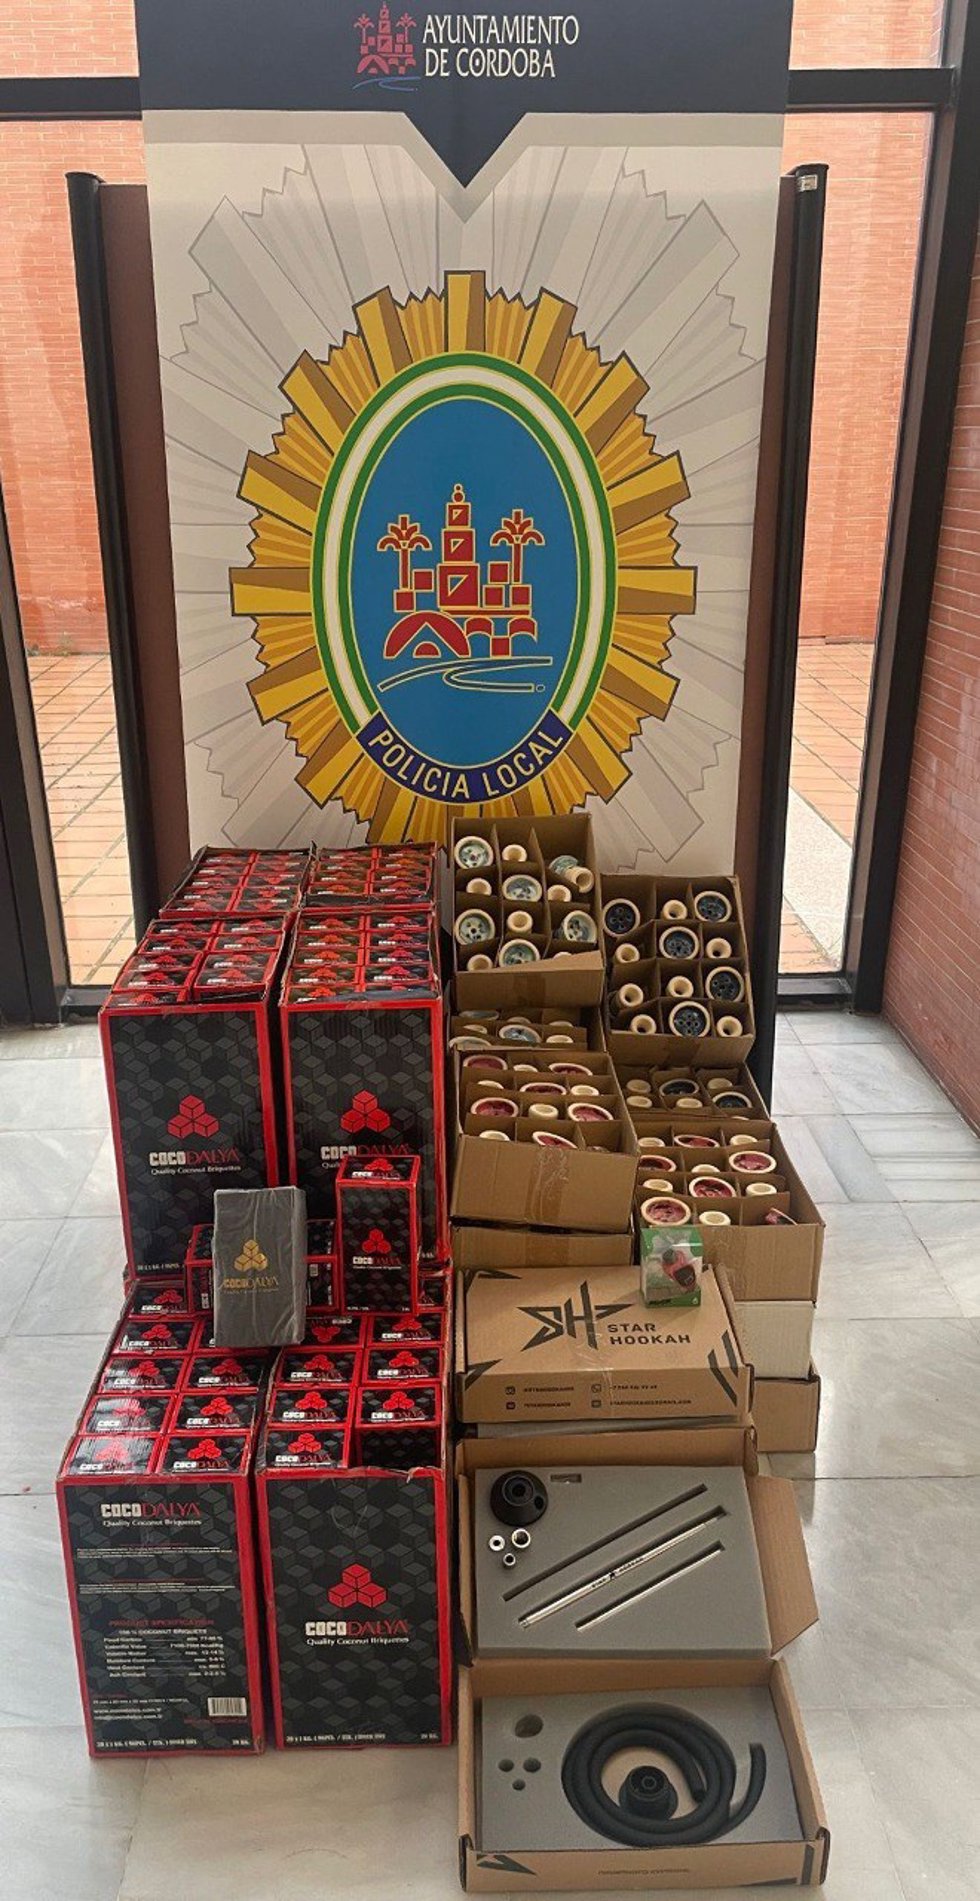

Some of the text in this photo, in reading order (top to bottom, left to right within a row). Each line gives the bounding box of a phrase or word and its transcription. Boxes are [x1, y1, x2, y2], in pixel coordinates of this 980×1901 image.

[422, 14, 580, 45] AYUNTAMIENTO
[425, 48, 450, 77] DE
[368, 729, 564, 799] POLICIA LOCAL
[607, 1322, 656, 1333] STAR
[609, 1334, 691, 1346] HOOKAH
[103, 1519, 130, 1527] Quality
[307, 1638, 335, 1646] Quality
[337, 1637, 369, 1645] Coconut
